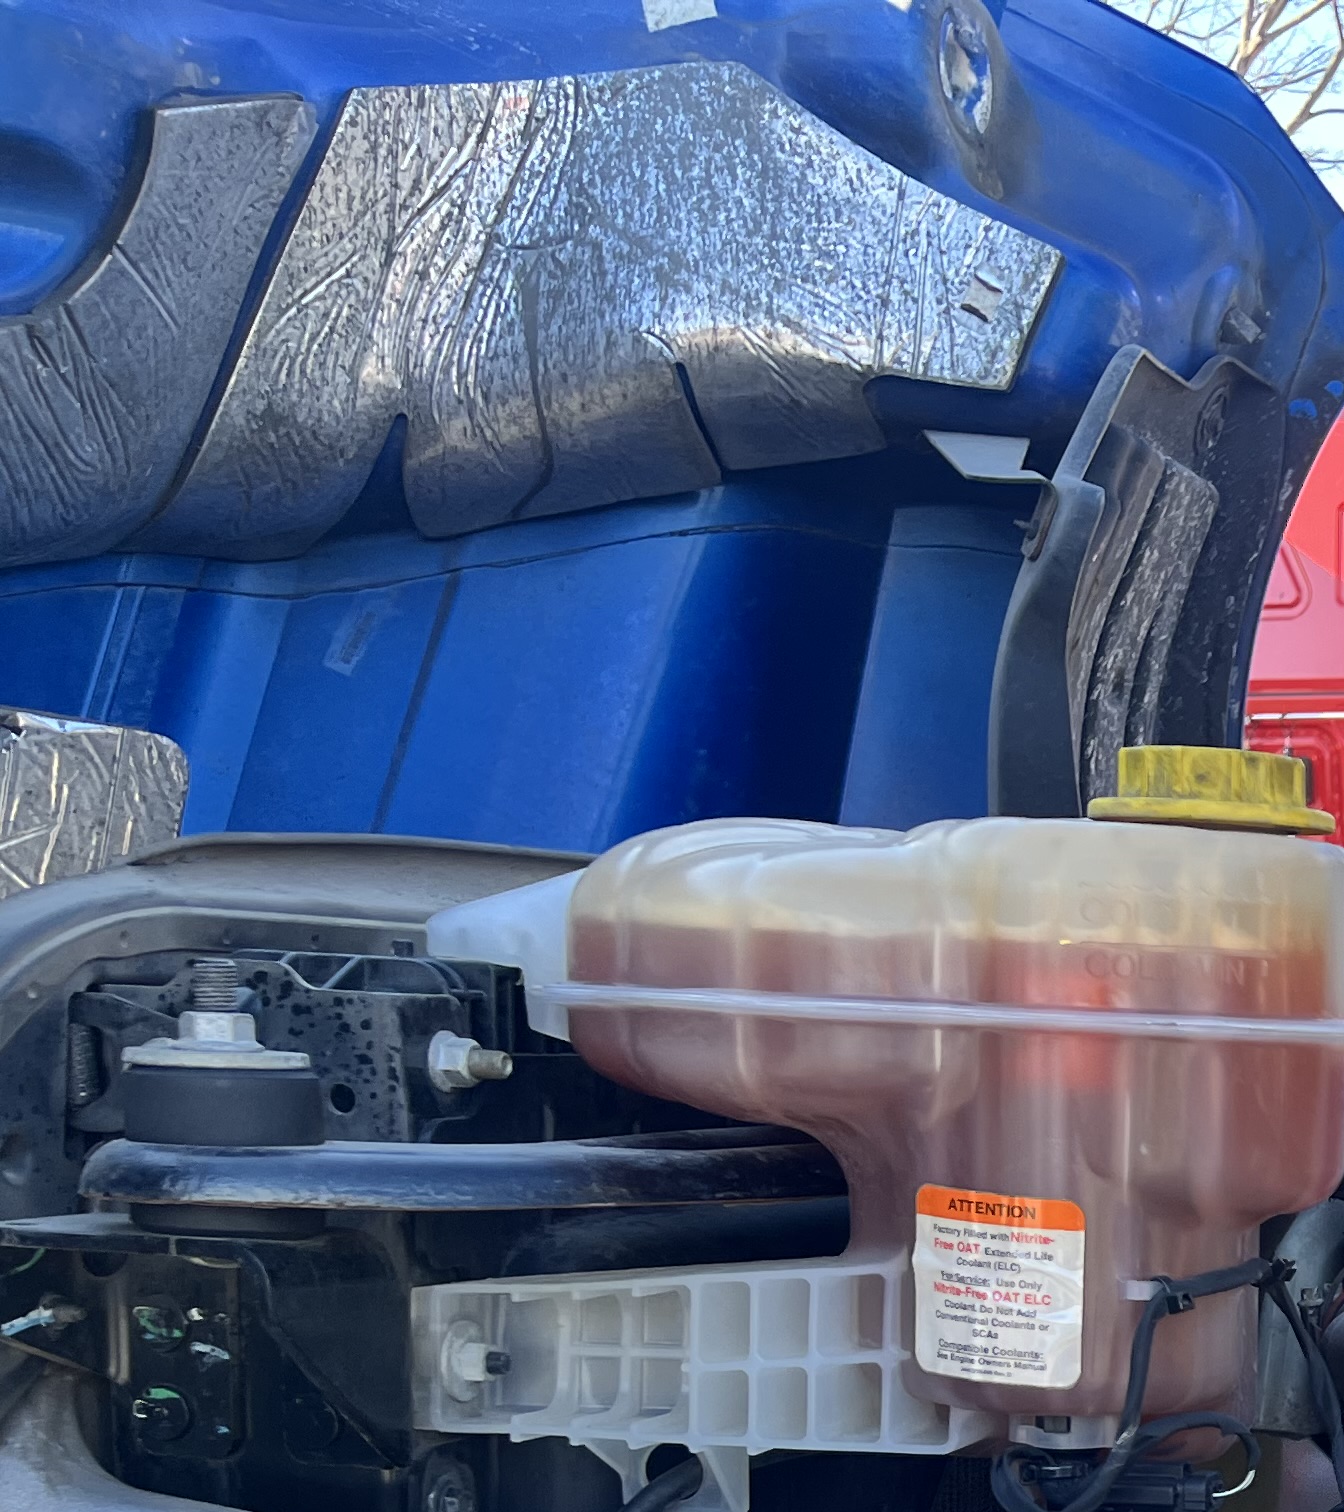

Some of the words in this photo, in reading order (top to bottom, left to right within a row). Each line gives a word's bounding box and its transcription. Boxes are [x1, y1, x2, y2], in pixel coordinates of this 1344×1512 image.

[948, 1198, 1036, 1220] ATTENTION
[990, 1231, 1009, 1242] with
[934, 1238, 954, 1250] Free
[957, 1241, 981, 1253] OAT
[984, 1247, 1031, 1260] Extended
[1034, 1252, 1054, 1262] Life
[956, 1256, 992, 1269] Coolant
[993, 1261, 1022, 1274] (ELC)
[933, 1281, 988, 1301] Nitrite-Free
[992, 1291, 1020, 1303] OAT
[1024, 1293, 1052, 1306] ELC
[995, 1278, 1015, 1288] Use
[1019, 1280, 1043, 1292] Only
[935, 1310, 989, 1326] Conventional
[991, 1318, 1036, 1331] Coolants
[1038, 1323, 1050, 1331] or
[979, 1305, 993, 1314] Do
[996, 1306, 1013, 1315] Not
[1016, 1308, 1037, 1319] Add
[971, 1329, 999, 1339] SCAs
[938, 1339, 989, 1354] Compatible
[991, 1346, 1044, 1360] Coolants:
[950, 1353, 975, 1365] Engine
[1014, 1361, 1047, 1371] Manual
